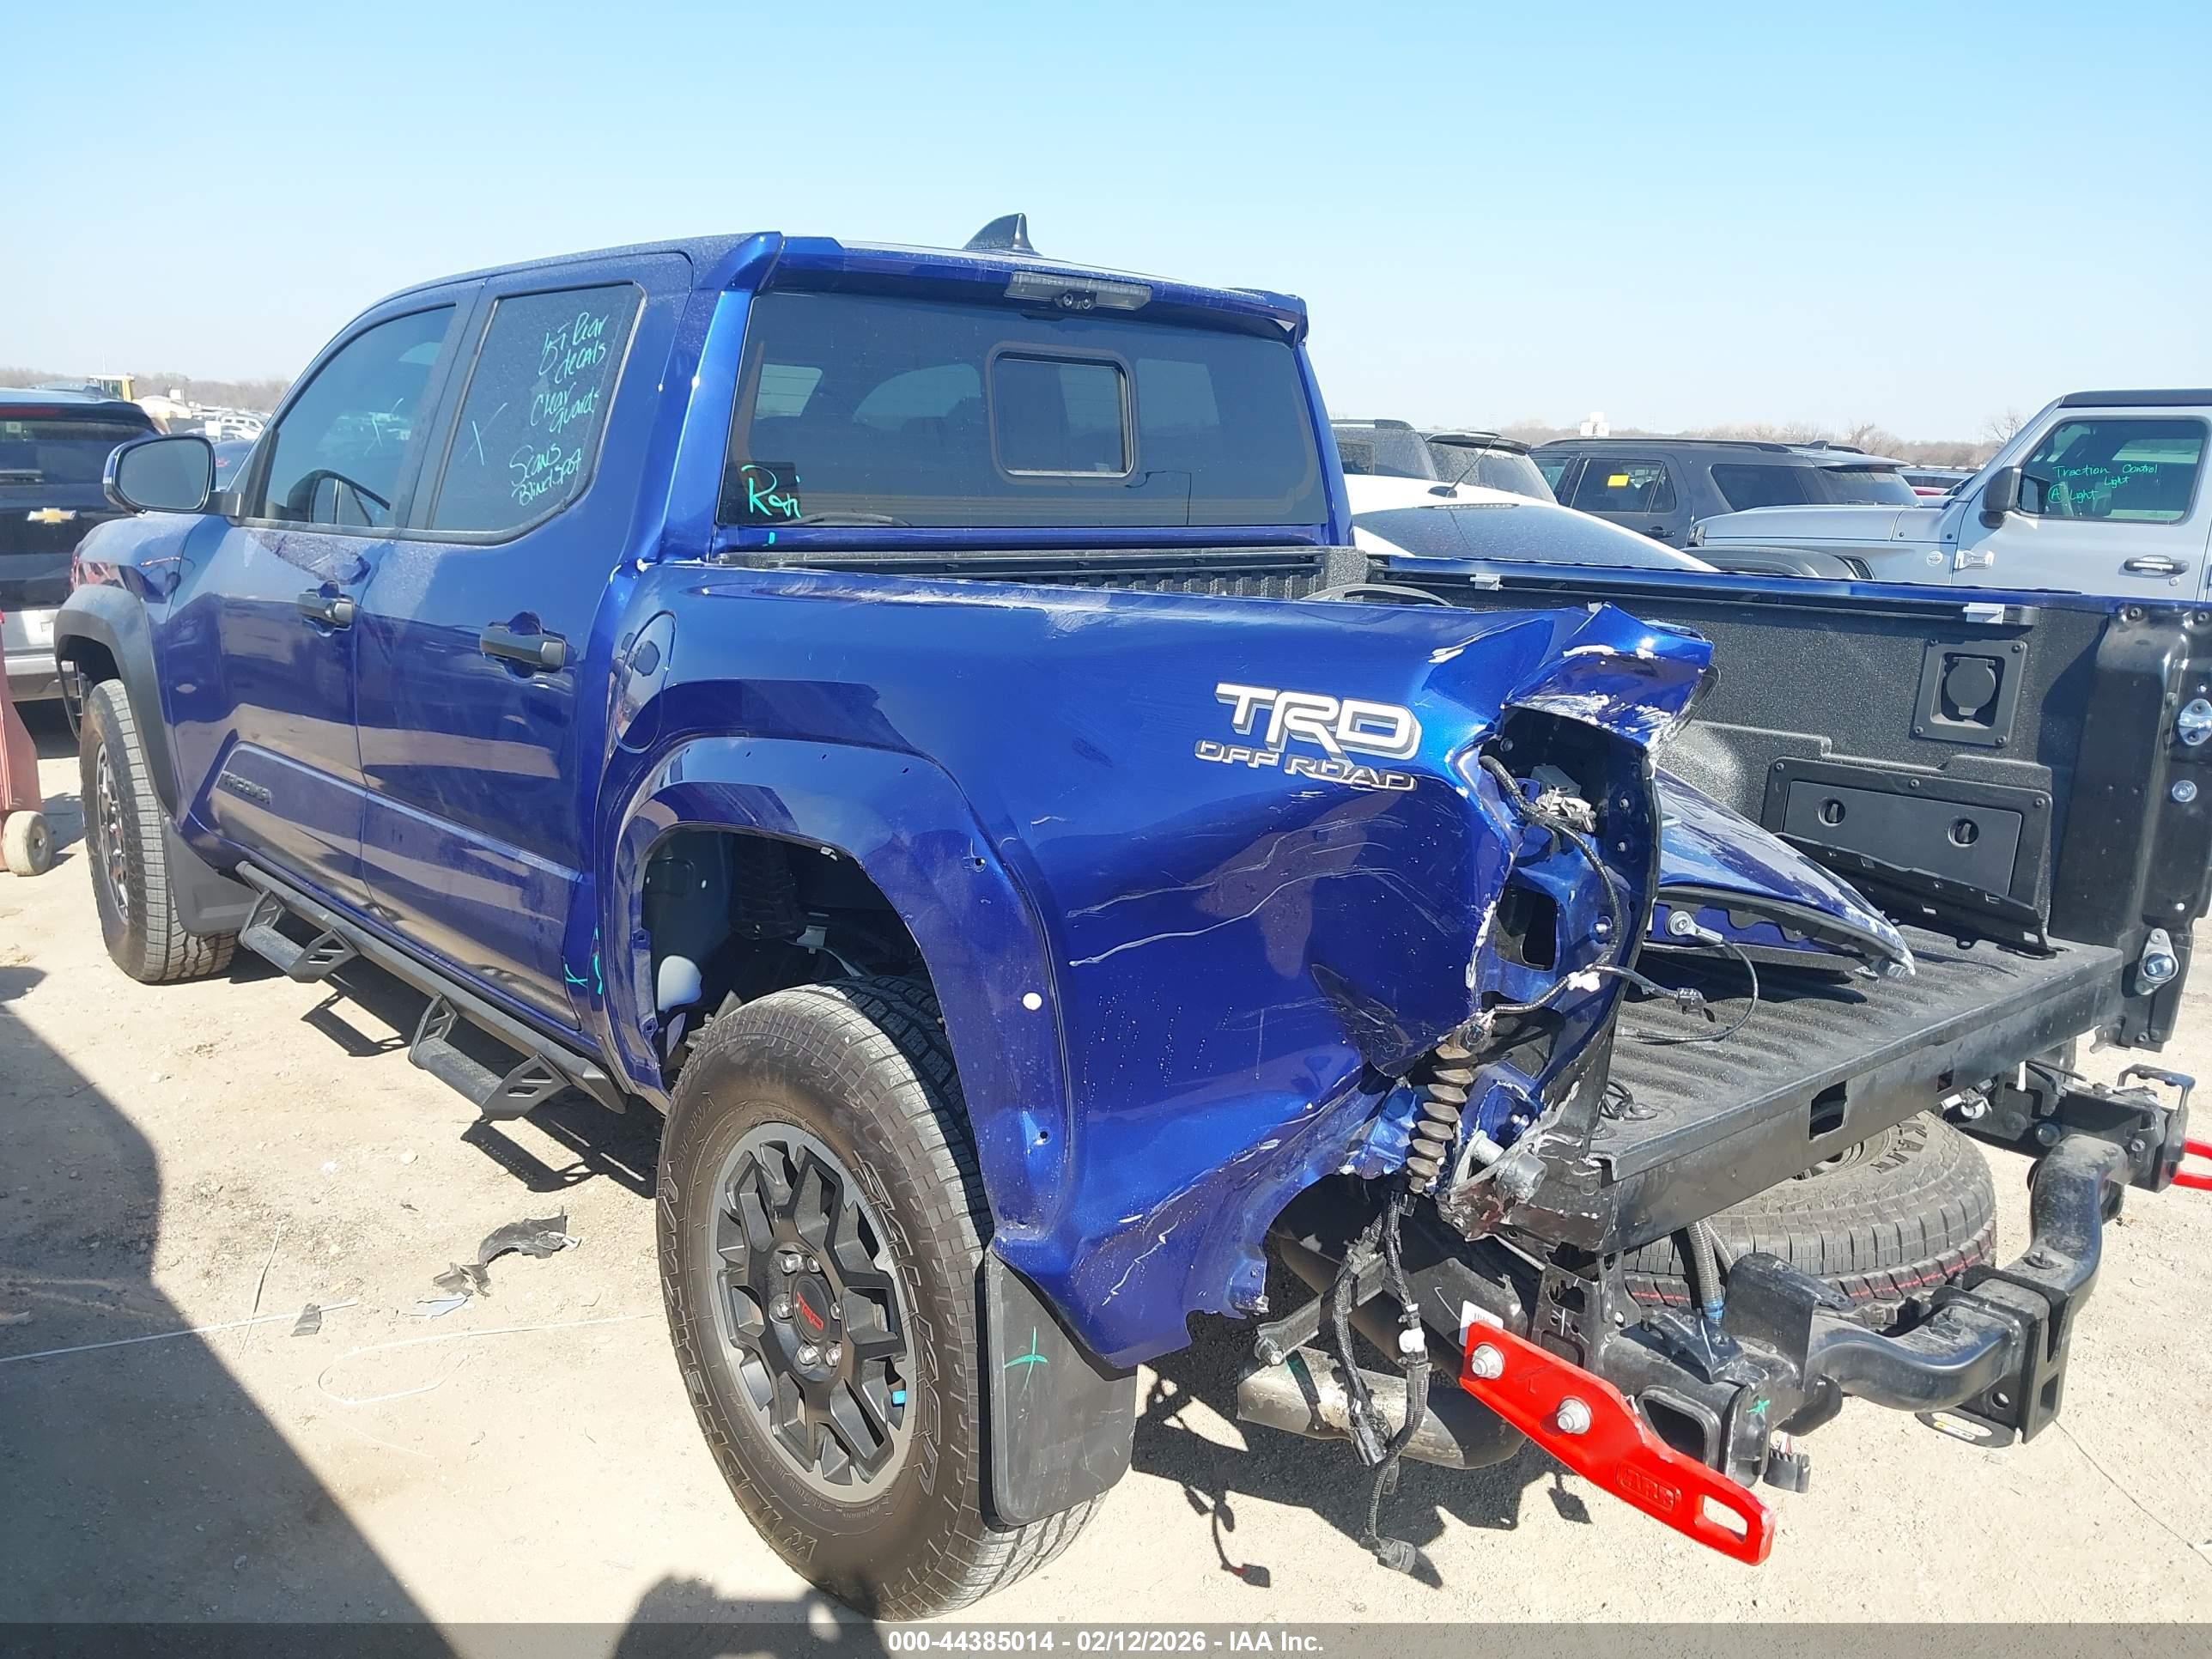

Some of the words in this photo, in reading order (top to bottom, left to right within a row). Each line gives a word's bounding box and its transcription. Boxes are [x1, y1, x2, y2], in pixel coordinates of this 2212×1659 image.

[2052, 465, 2111, 478] Traction
[2123, 464, 2158, 474] Control
[2104, 475, 2130, 489] Light
[2069, 489, 2099, 503] Light
[1215, 683, 1422, 761] TRD
[1194, 739, 1279, 769] OFF
[1284, 753, 1417, 791] ROAD
